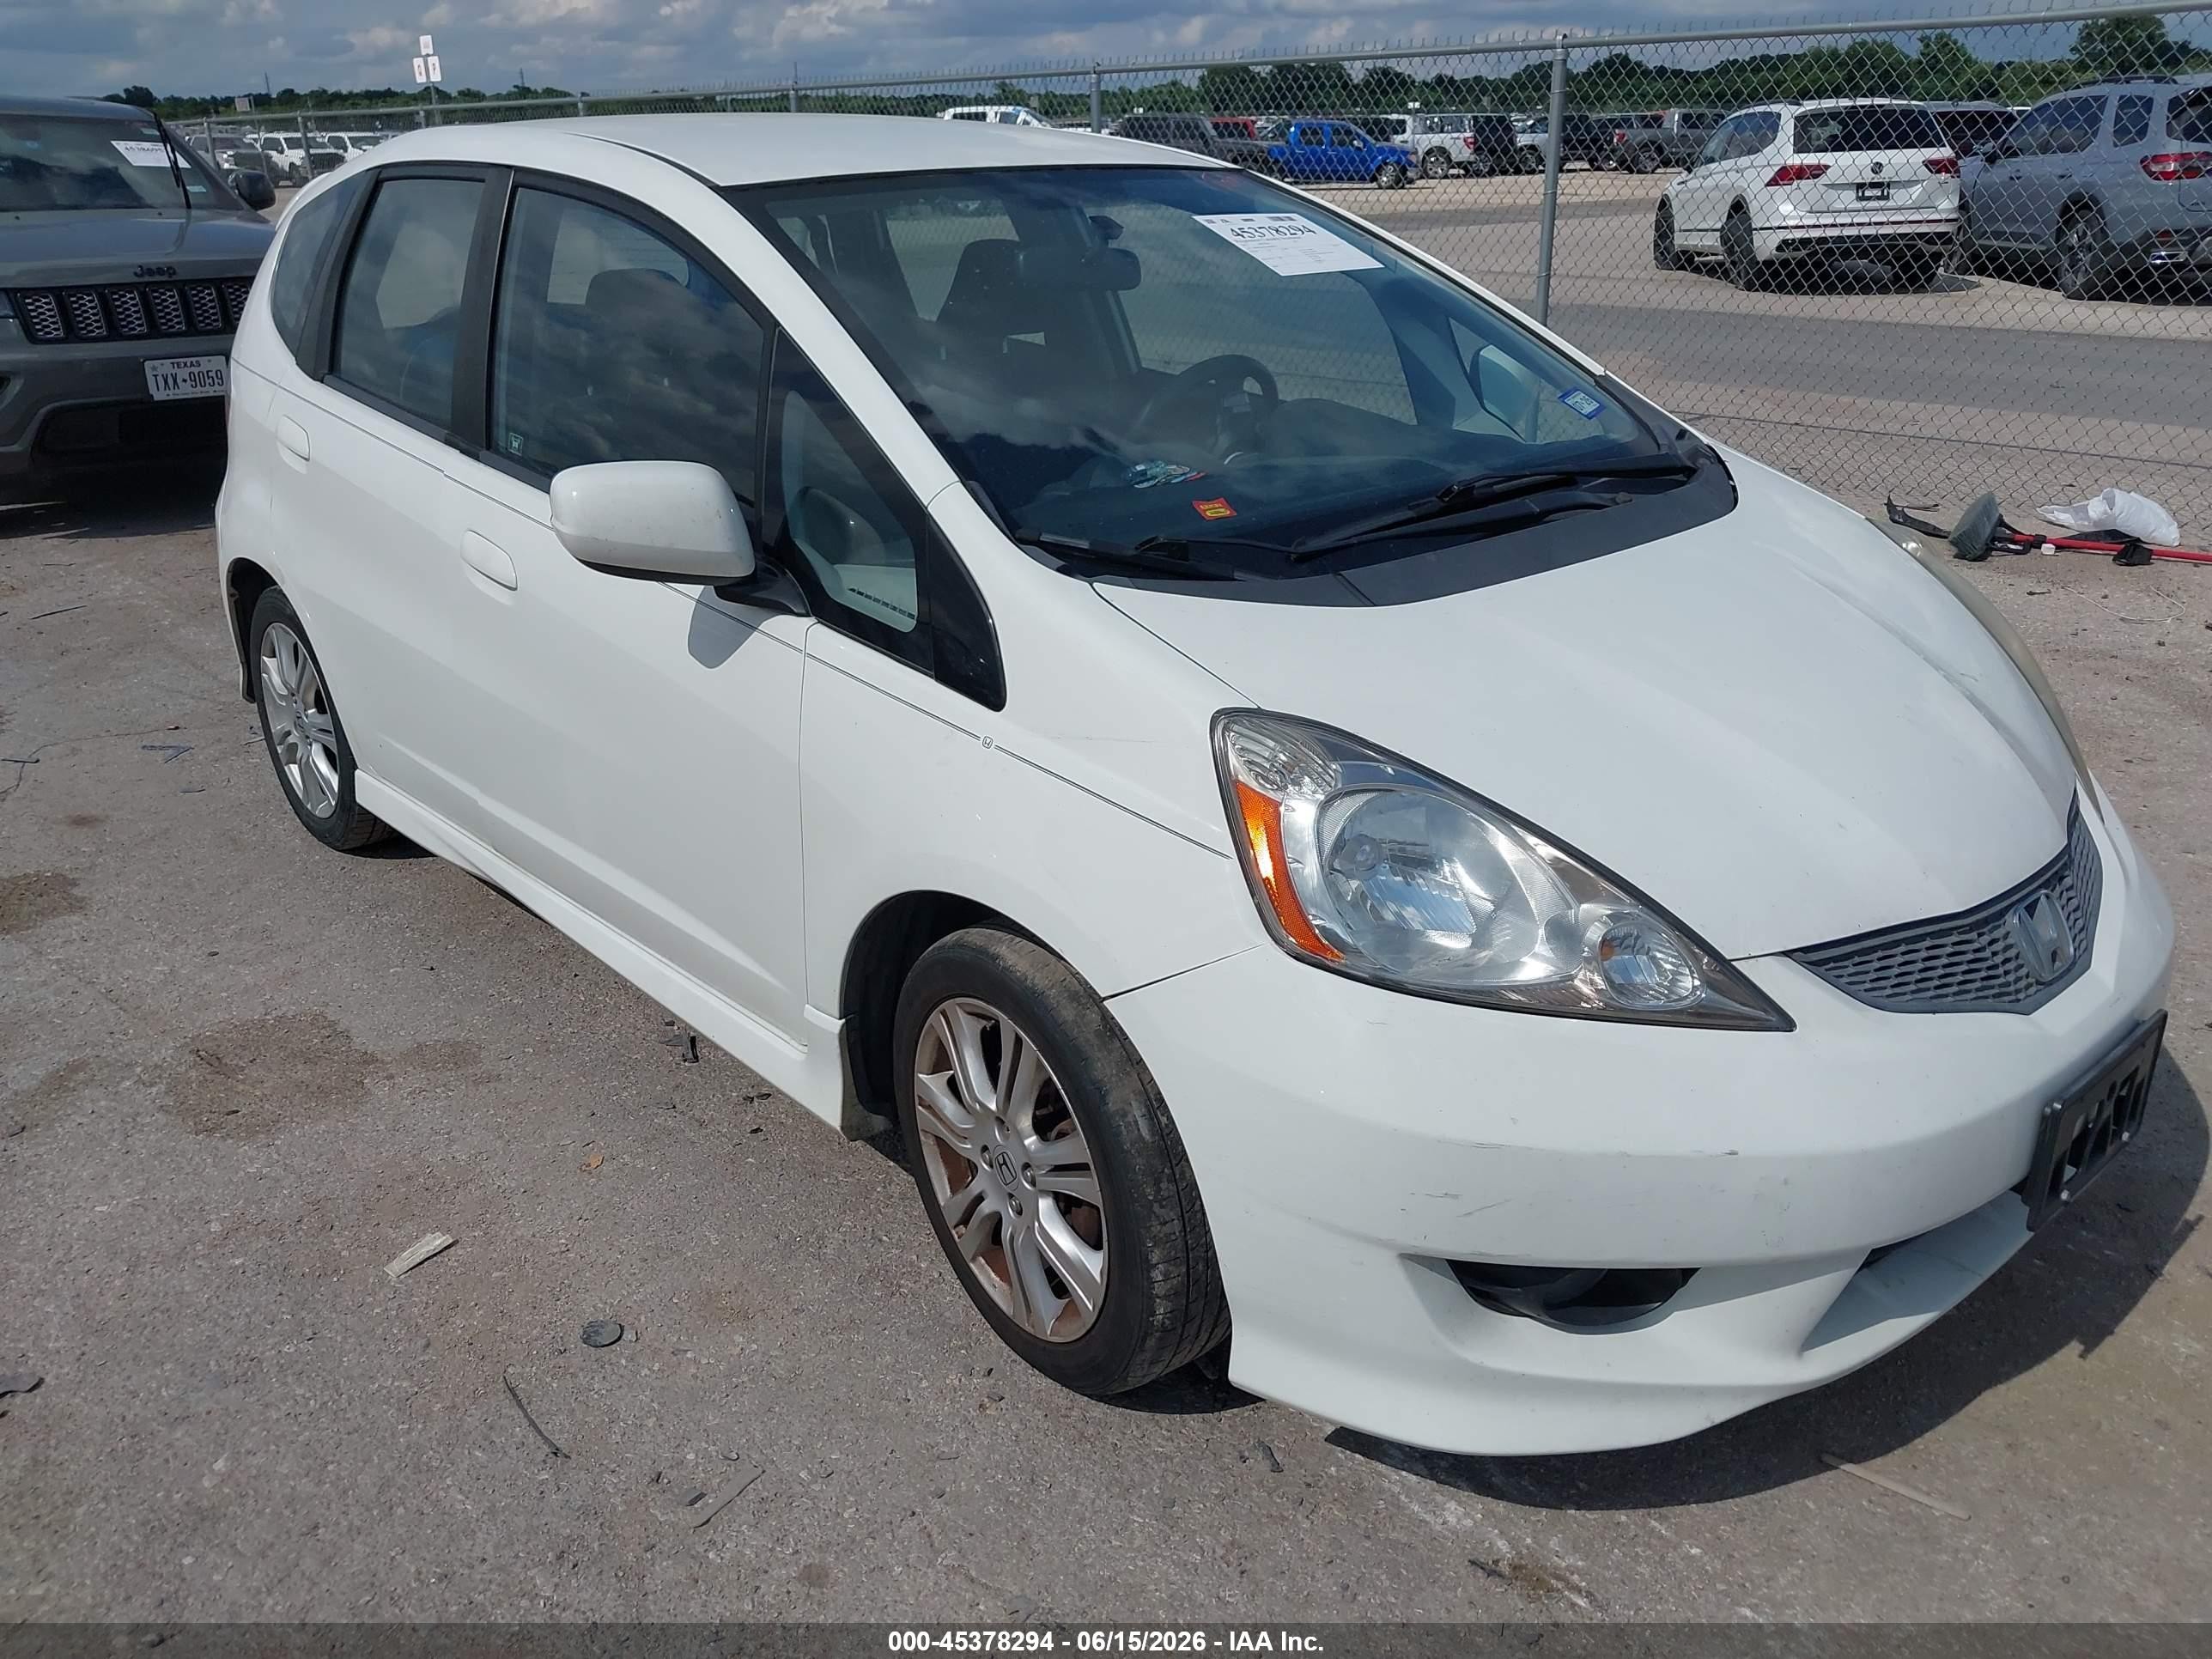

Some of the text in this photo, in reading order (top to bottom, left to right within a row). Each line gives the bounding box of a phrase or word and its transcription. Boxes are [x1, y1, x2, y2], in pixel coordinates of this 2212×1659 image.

[1230, 224, 1317, 240] 45378294
[133, 264, 177, 278] Jeep
[170, 360, 201, 369] TEXAS
